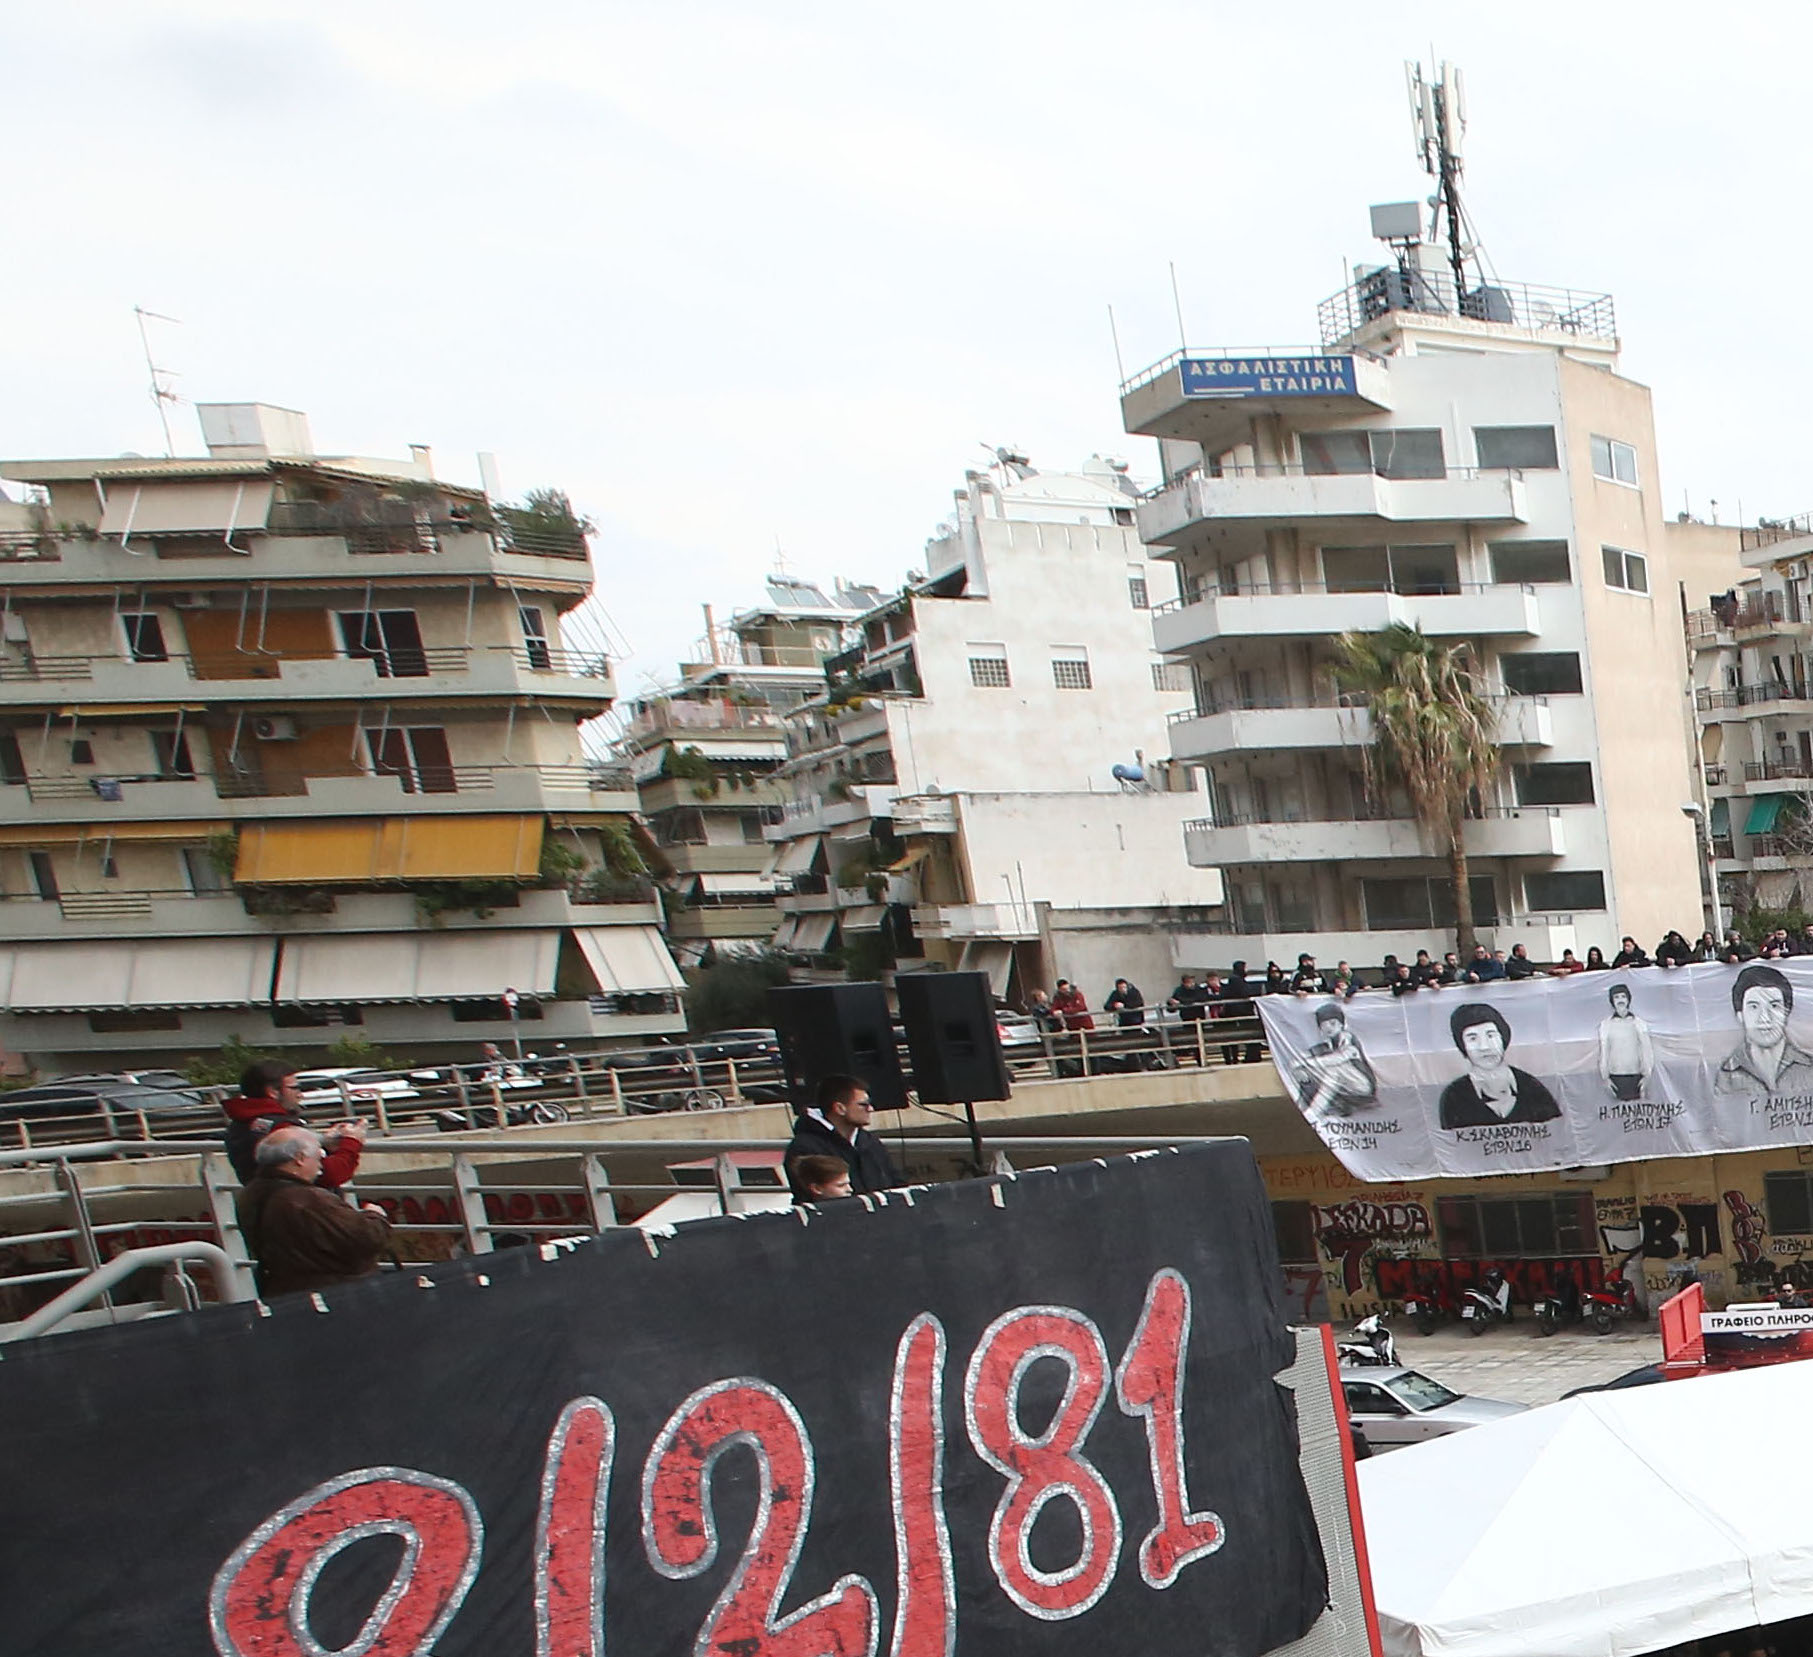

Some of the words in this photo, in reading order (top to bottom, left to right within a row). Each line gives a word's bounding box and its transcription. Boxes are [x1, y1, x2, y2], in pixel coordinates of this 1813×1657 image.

[1190, 359, 1344, 376] ΑΣΦΑΛΙΣΤΙΚΗ
[1260, 376, 1347, 392] ΕΤΑΙΡΙΑ
[1656, 1117, 1672, 1130] 17
[1362, 1136, 1378, 1149] 14
[1711, 1315, 1764, 1328] ΓΡΑΦΕΙΟ
